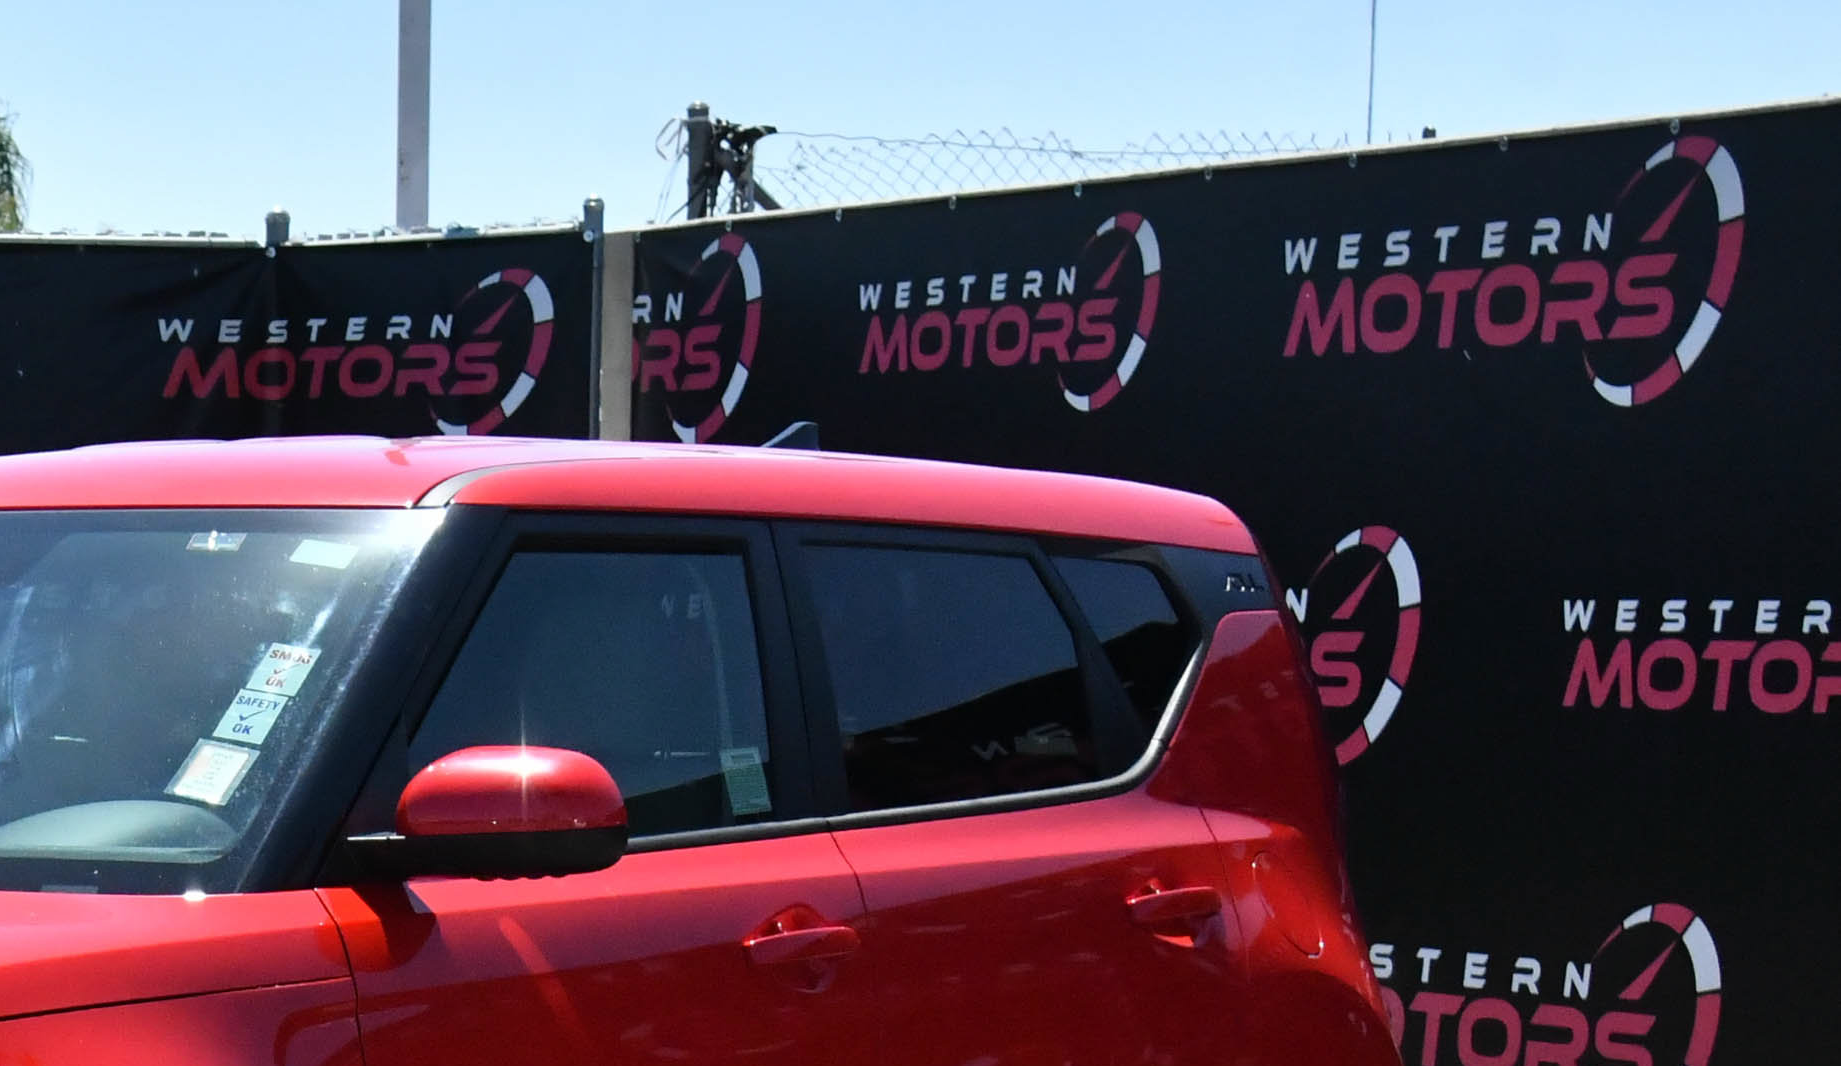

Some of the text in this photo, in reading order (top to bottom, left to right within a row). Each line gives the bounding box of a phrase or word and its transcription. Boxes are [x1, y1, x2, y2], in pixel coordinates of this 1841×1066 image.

[1284, 212, 1613, 275] WESTERN
[859, 266, 1076, 311] WESTERN
[1284, 253, 1677, 356] MOTORS
[158, 314, 453, 343] WESTERN
[860, 298, 1117, 373] MOTORS
[163, 341, 500, 401] MOTORS
[1563, 599, 1832, 634] WESTER
[236, 695, 280, 711] SAFETY
[232, 723, 254, 736] OK
[1369, 943, 1592, 1000] STERN
